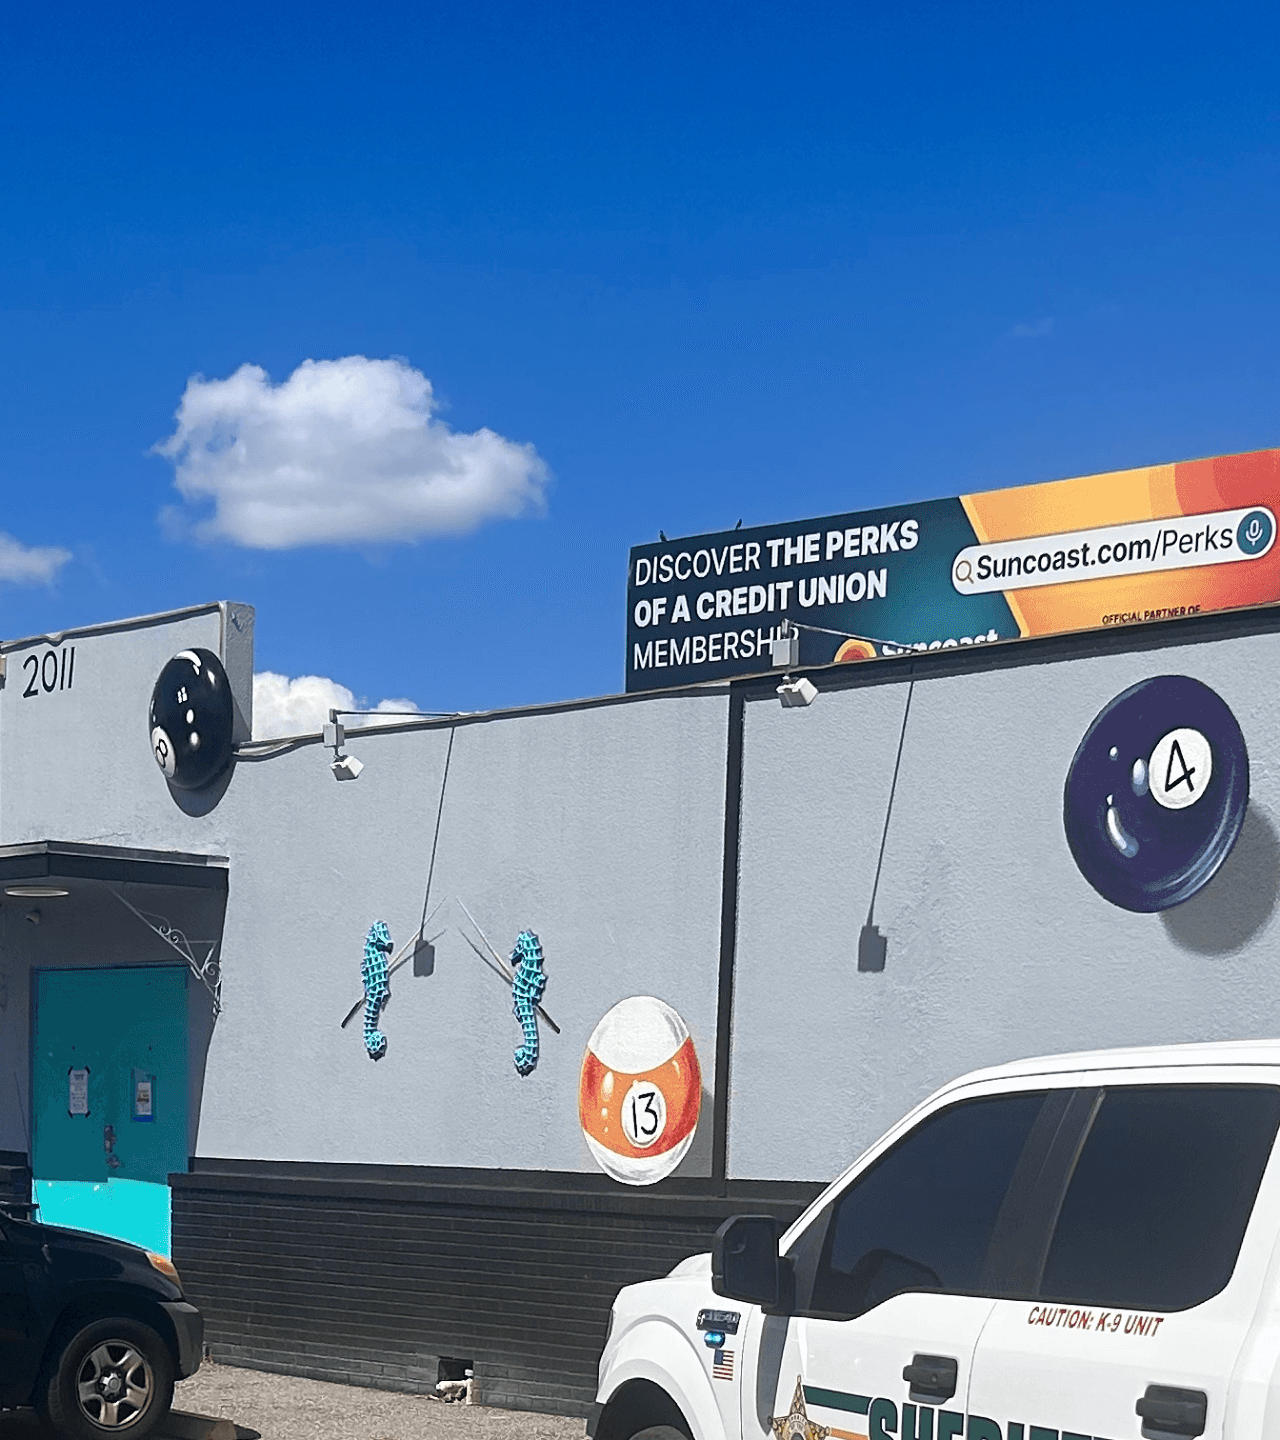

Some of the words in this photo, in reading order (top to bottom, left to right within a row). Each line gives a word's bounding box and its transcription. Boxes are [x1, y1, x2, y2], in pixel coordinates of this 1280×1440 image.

[634, 541, 761, 587] DISCOVER
[766, 532, 823, 568] THE
[825, 519, 920, 561] PERKS
[976, 524, 1234, 580] Suncoast.com/Perks
[634, 597, 669, 628] OF
[670, 594, 692, 624] A
[695, 581, 795, 620] CREDIT
[797, 567, 888, 608] UNION
[1102, 611, 1142, 625] OFFICIAL
[1144, 606, 1186, 621] PARTNER
[1187, 604, 1201, 615] OF
[22, 646, 76, 699] 2011
[1164, 738, 1196, 793] 4
[631, 1091, 659, 1139] 13
[1027, 1306, 1094, 1330] CAUTION:
[1095, 1311, 1123, 1333] K-9
[1124, 1314, 1165, 1337] UNIT
